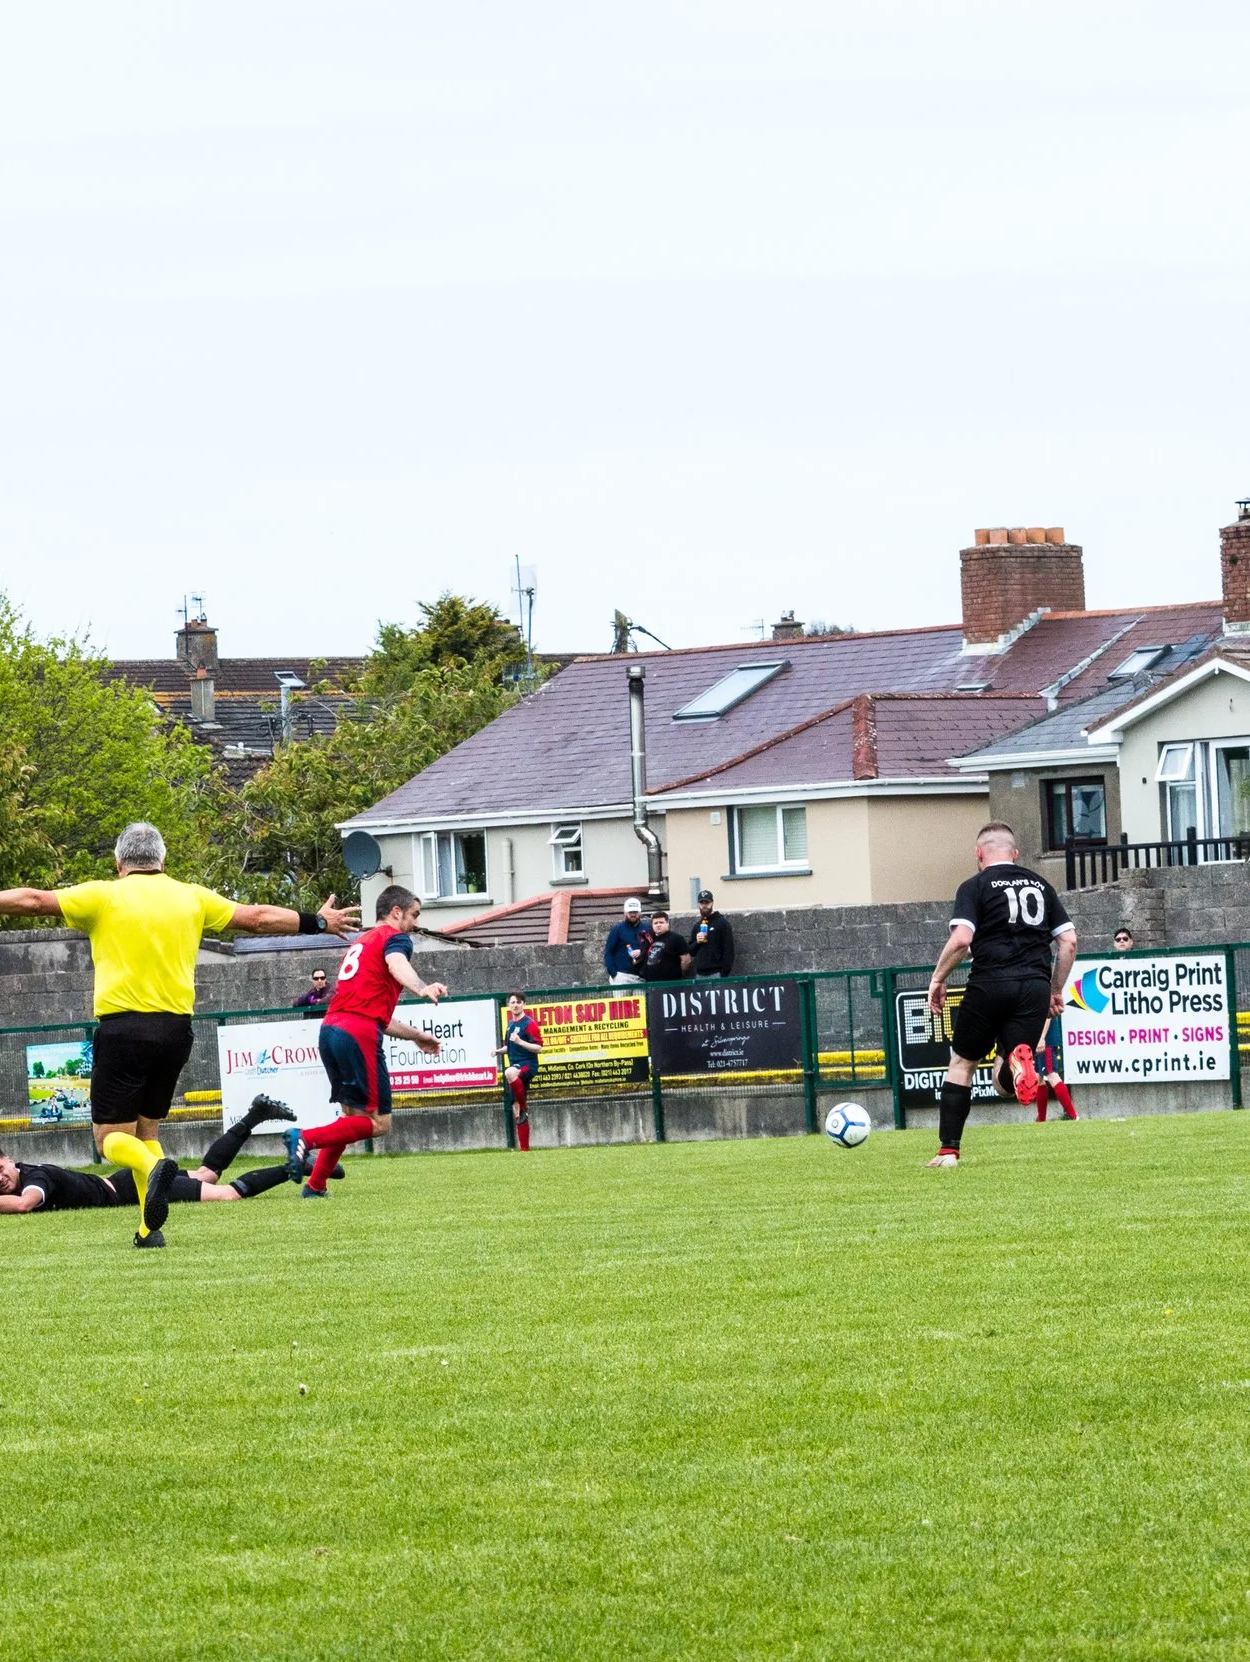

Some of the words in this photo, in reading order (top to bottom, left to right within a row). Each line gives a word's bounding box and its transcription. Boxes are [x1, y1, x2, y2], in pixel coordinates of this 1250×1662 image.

[1003, 886, 1045, 925] 10
[338, 943, 363, 980] 8
[1099, 964, 1169, 992] Carraig
[1175, 962, 1222, 986] Print
[507, 1004, 573, 1027] LETON
[575, 1002, 606, 1025] SKIP
[608, 999, 641, 1020] HIRE
[662, 986, 785, 1018] DISTRICT
[1111, 990, 1163, 1015] Litho
[1169, 990, 1223, 1013] Press
[422, 1018, 464, 1040] Heart
[543, 1024, 587, 1035] MANAGEMENT
[594, 1021, 630, 1031] RECYCLING
[681, 1023, 716, 1032] HEALTH
[720, 1022, 726, 1031] &
[730, 1020, 769, 1030] LEISURE
[1067, 1030, 1116, 1046] DESIGN
[1129, 1028, 1170, 1044] PRINT
[1182, 1026, 1224, 1042] SIGNS
[226, 1049, 254, 1074] JIM
[271, 1045, 319, 1065] CROW
[390, 1043, 467, 1067] Foundation
[1077, 1051, 1216, 1077] www.cprint.ie
[904, 1071, 949, 1090] DIGIT
